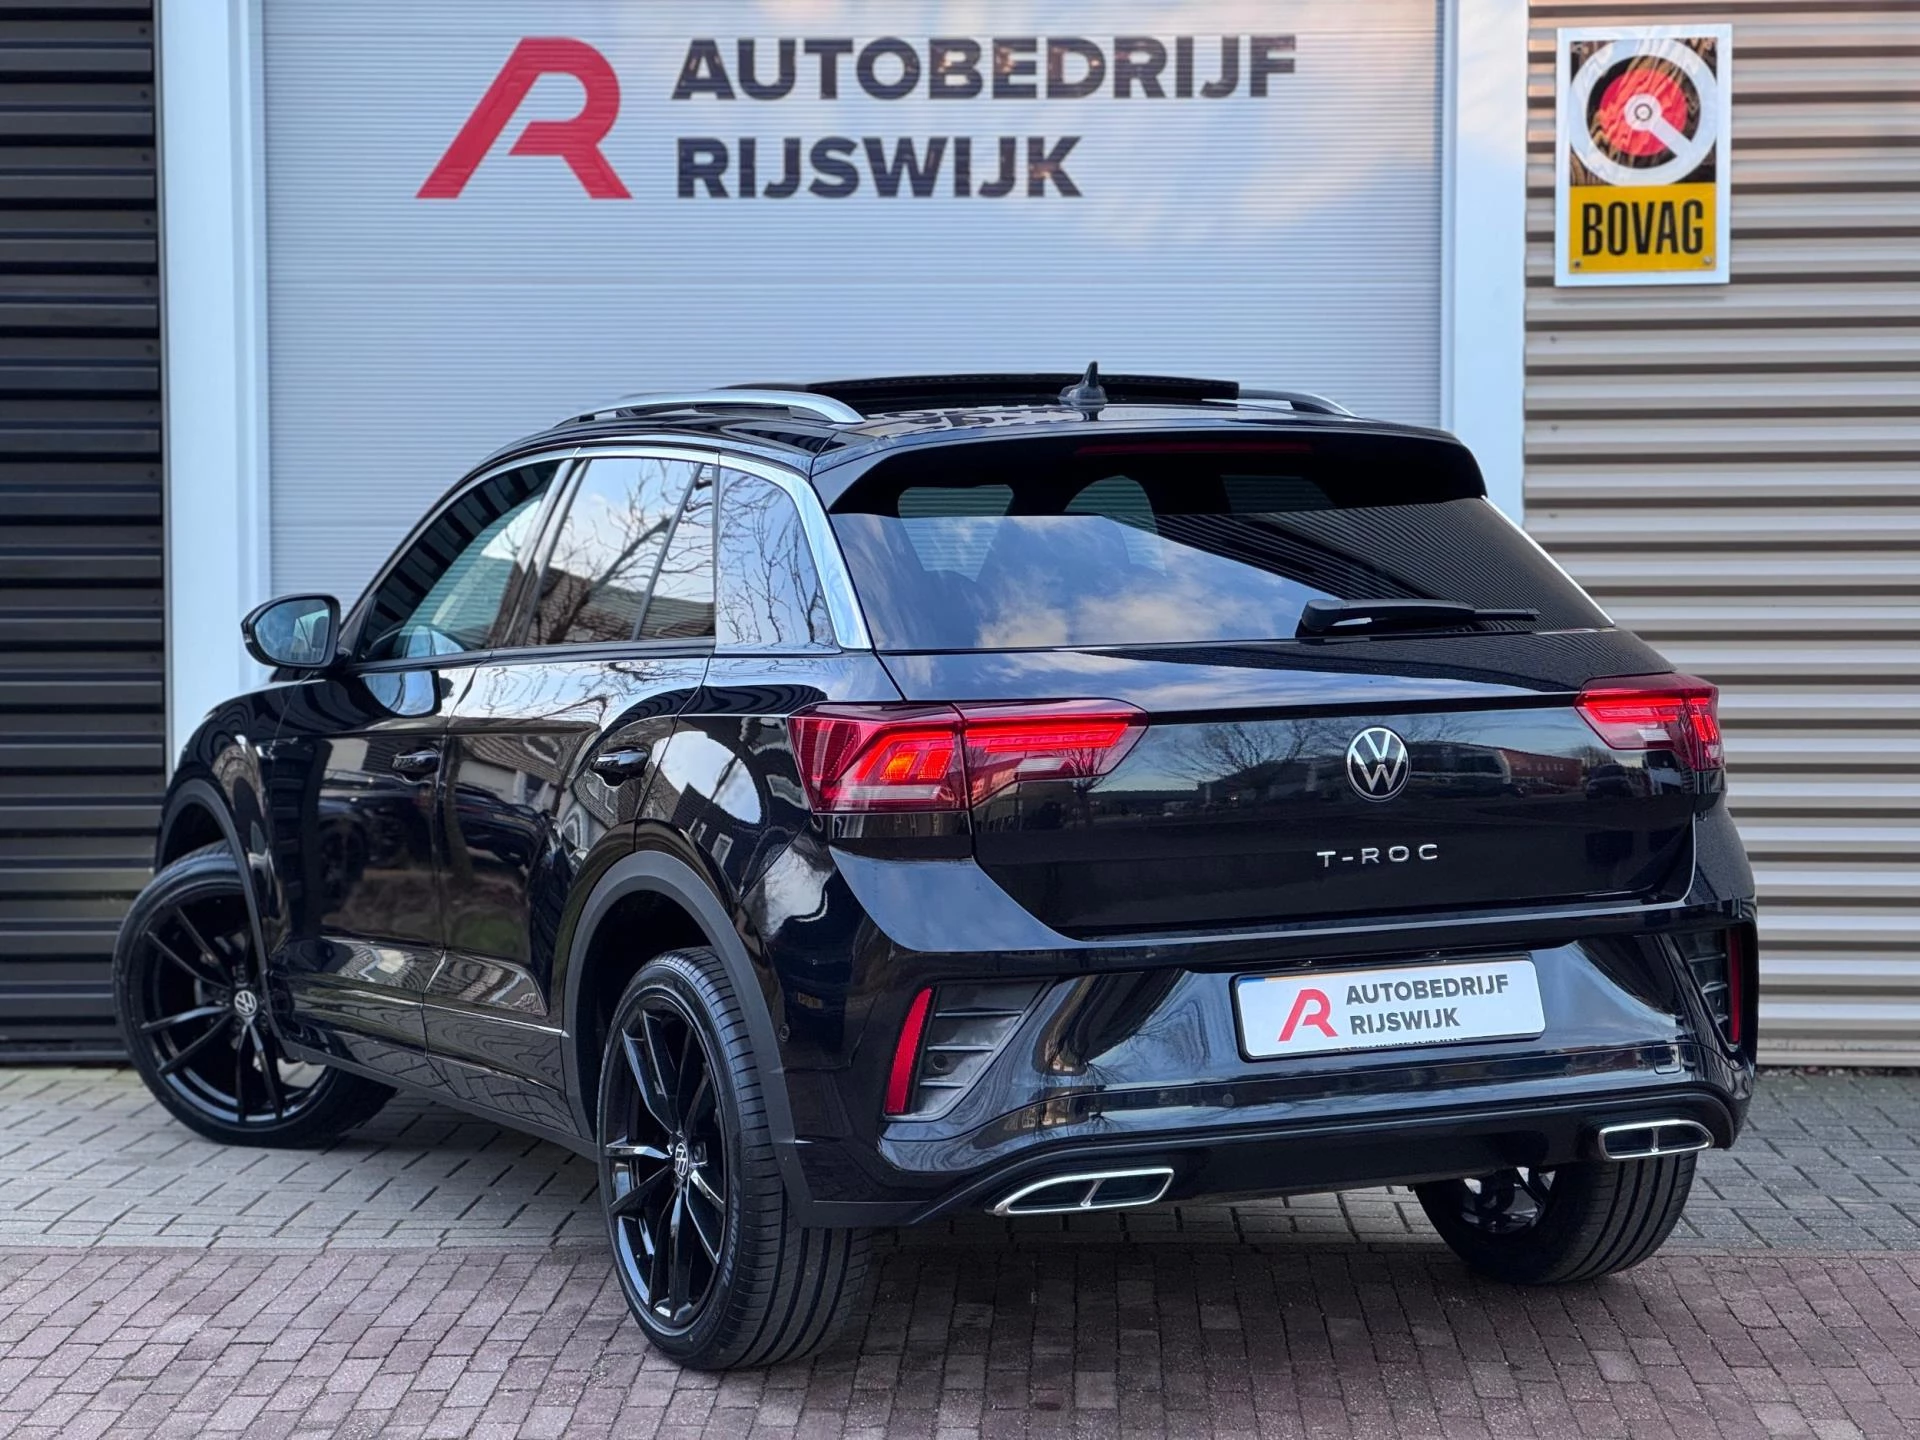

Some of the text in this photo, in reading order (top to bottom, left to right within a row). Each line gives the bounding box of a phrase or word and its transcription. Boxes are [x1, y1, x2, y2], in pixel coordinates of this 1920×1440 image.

[671, 36, 1297, 100] AUTOBEDRIJF
[677, 136, 1083, 199] RIJSWIJK
[1582, 199, 1703, 256] BOVAG
[1316, 843, 1438, 868] T-ROC
[1346, 974, 1509, 1005] AUTOBEDRIJF
[1350, 1007, 1460, 1035] RIJSWIJK
